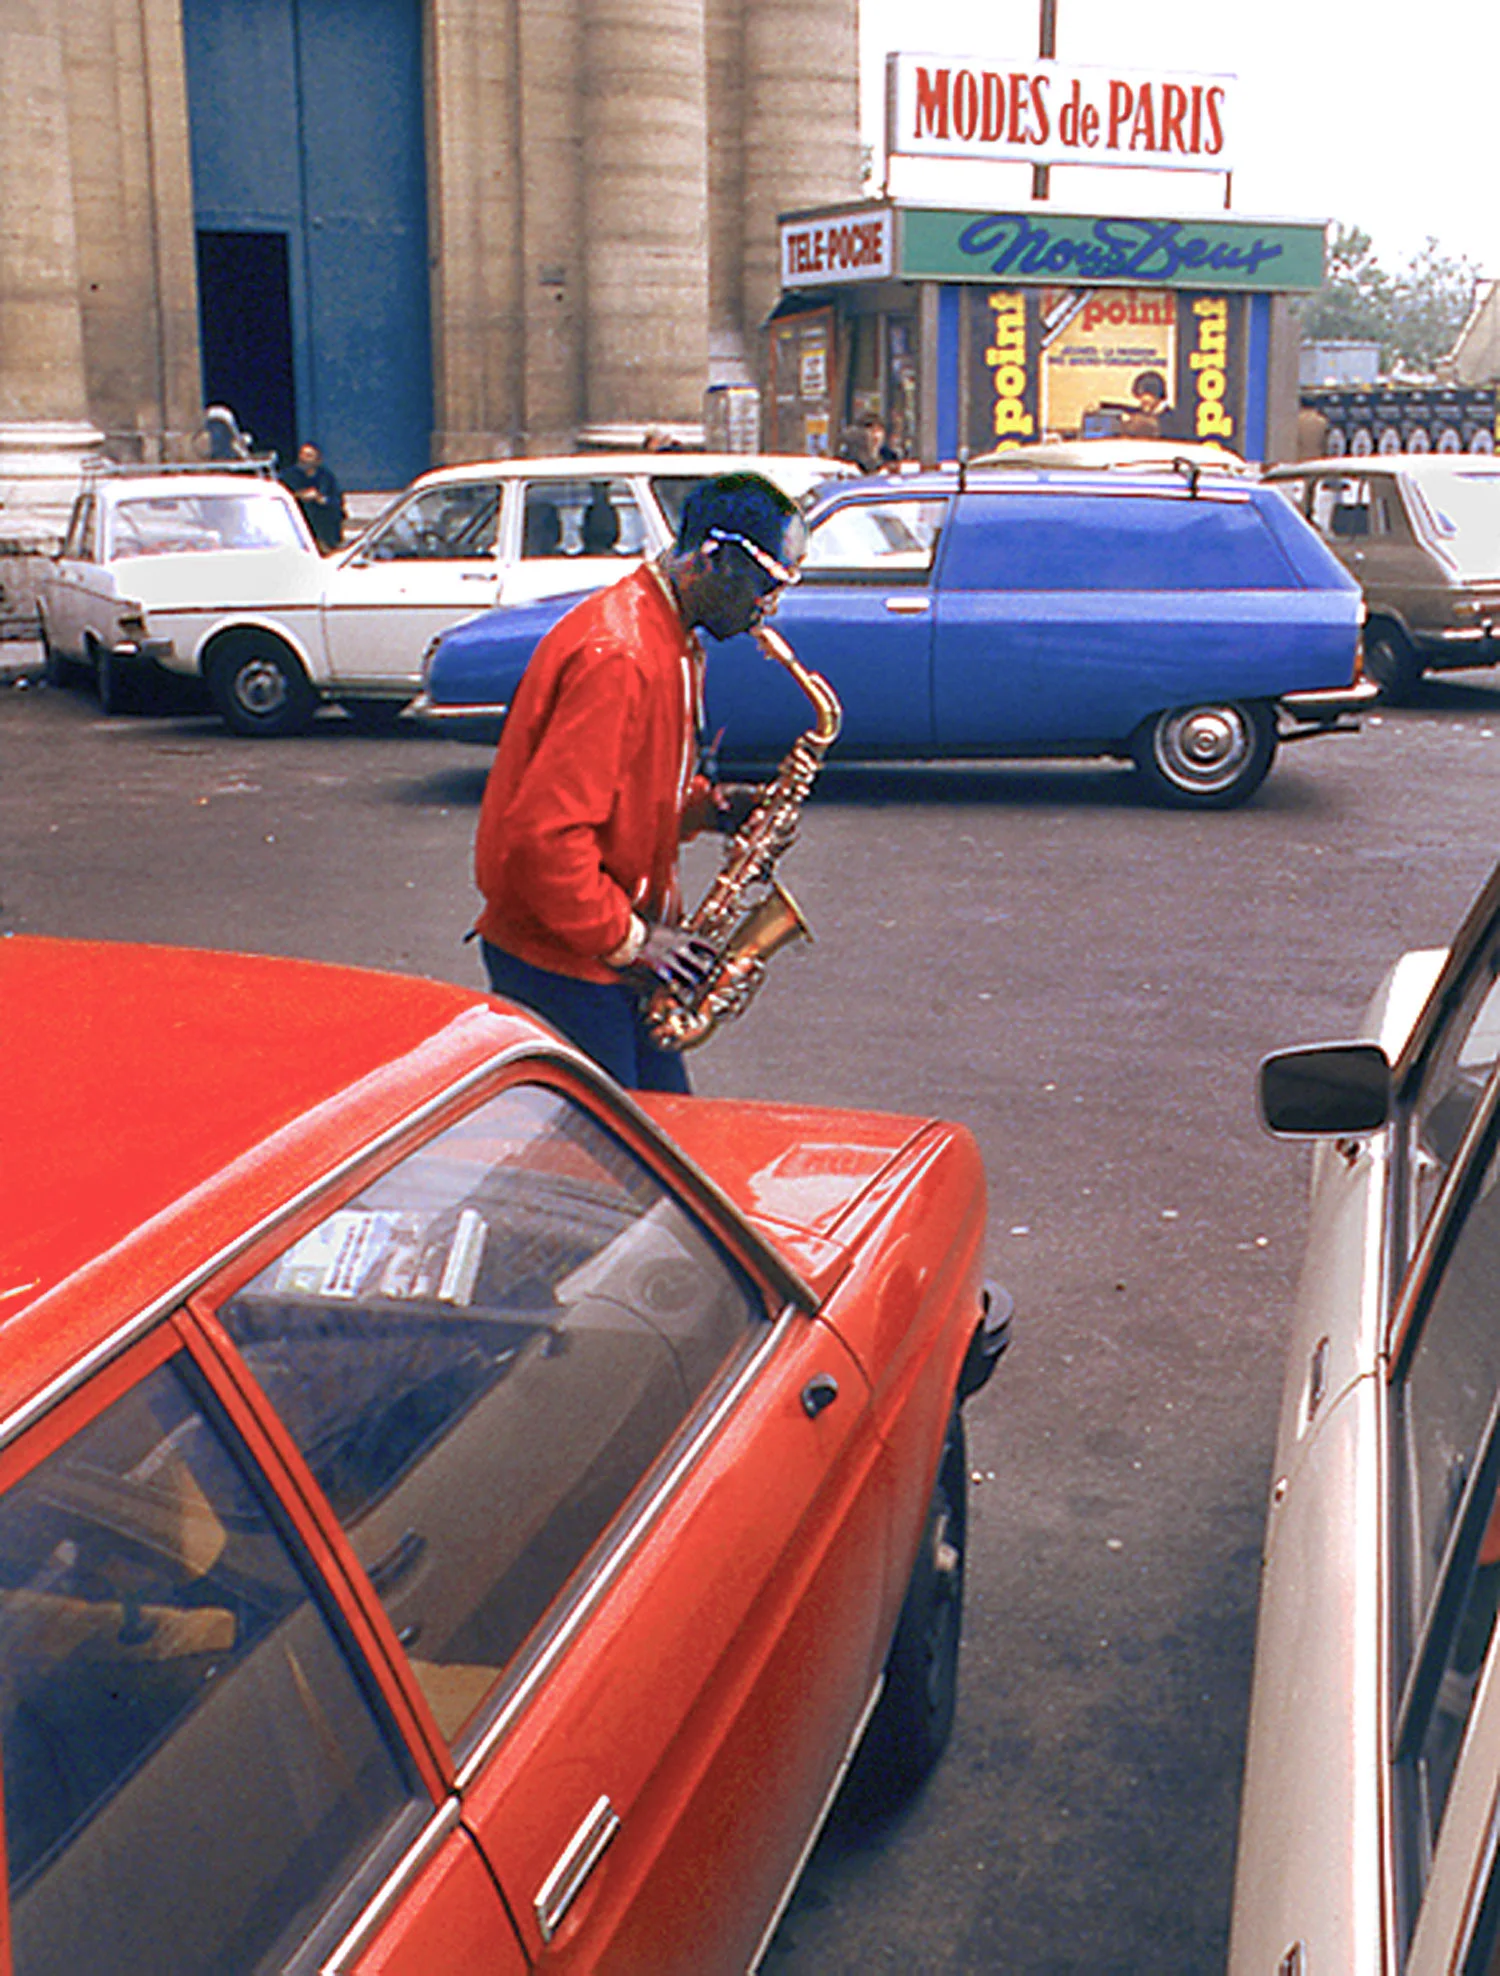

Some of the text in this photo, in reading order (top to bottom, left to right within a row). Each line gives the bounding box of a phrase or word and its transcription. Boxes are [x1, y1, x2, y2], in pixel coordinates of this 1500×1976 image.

[913, 66, 1225, 155] MODES de PARIS
[1093, 217, 1283, 281] Deux
[1080, 289, 1175, 332] point
[986, 291, 1034, 435] point
[1189, 298, 1233, 437] point
